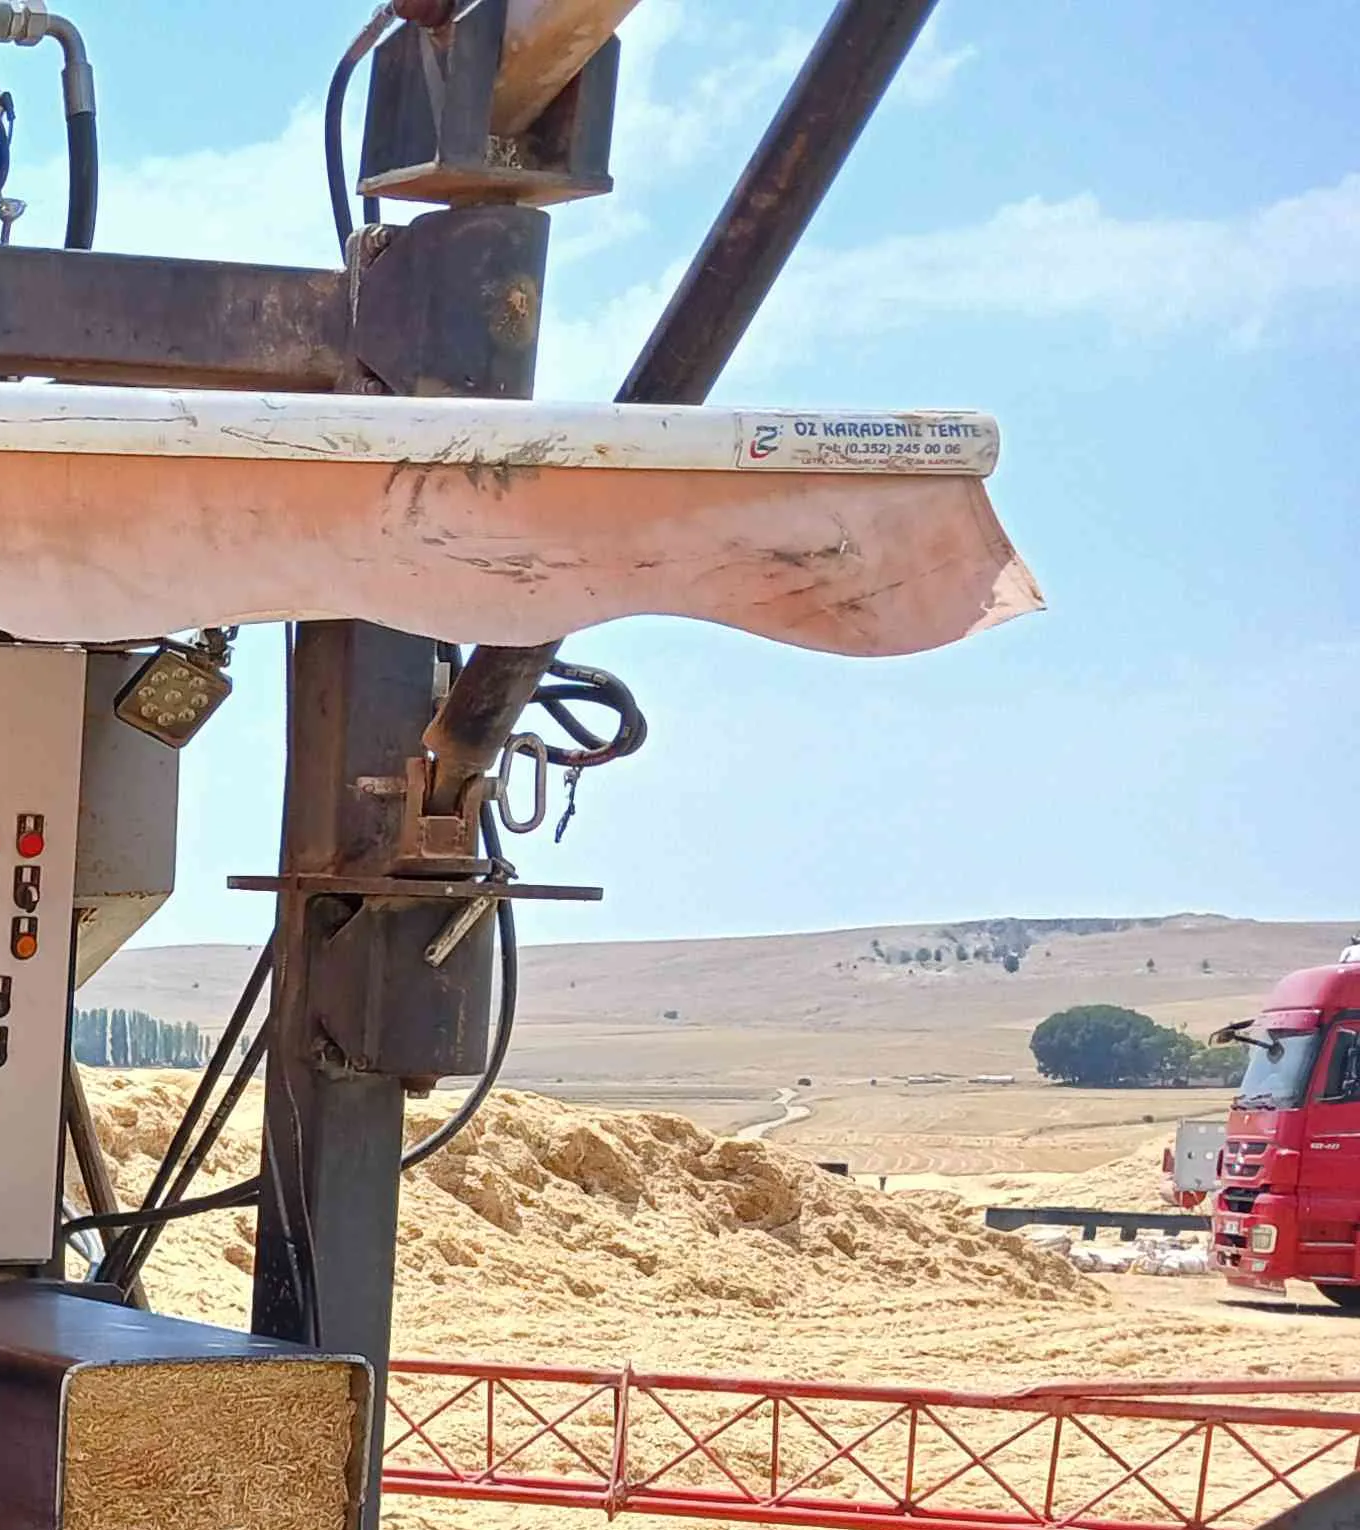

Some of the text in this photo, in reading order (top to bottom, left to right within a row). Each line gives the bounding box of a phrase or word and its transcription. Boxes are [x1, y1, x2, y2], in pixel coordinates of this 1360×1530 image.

[926, 423, 982, 438] TENTE
[895, 443, 921, 454] 245
[924, 443, 942, 455] 00
